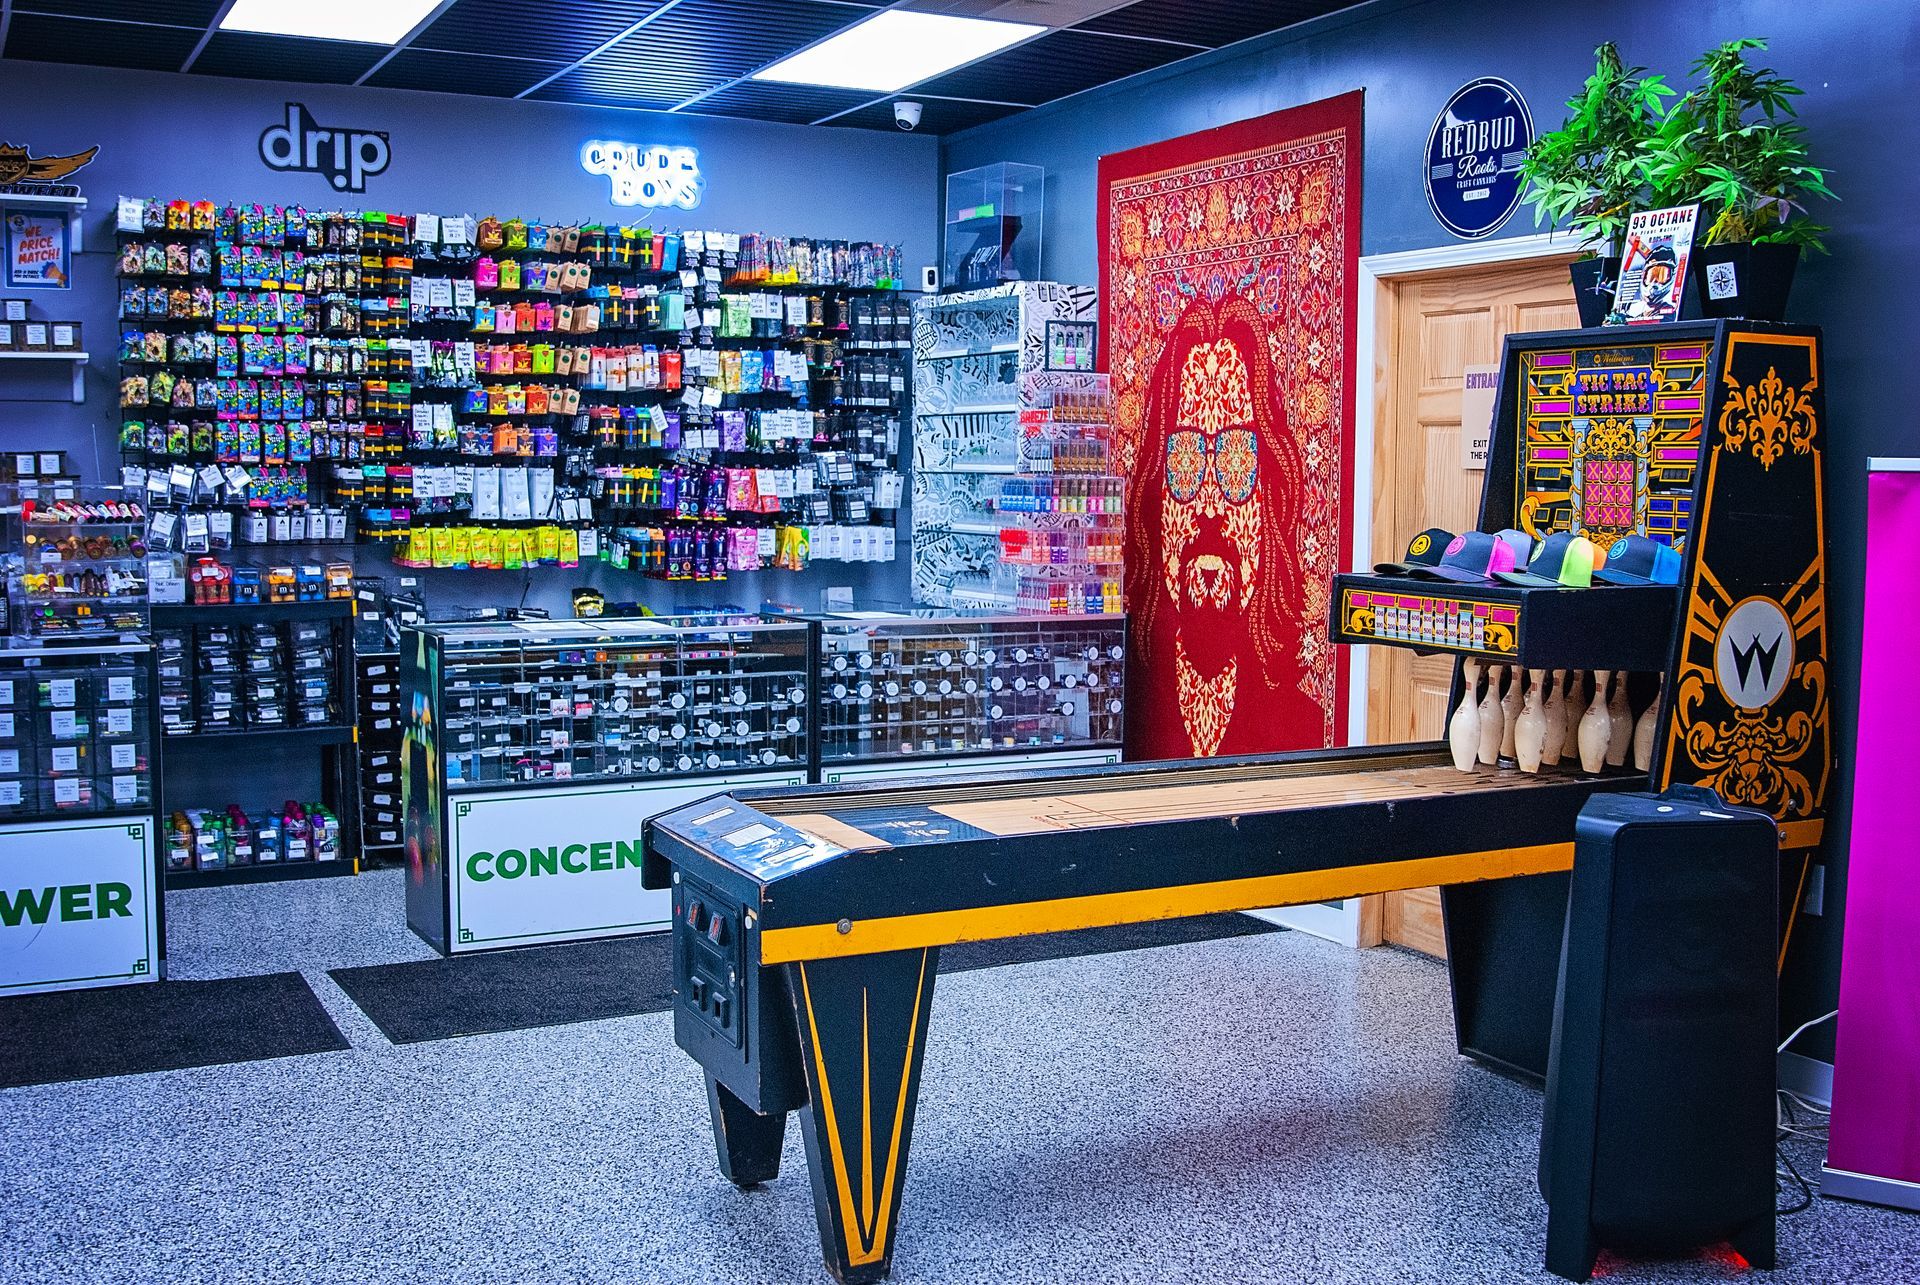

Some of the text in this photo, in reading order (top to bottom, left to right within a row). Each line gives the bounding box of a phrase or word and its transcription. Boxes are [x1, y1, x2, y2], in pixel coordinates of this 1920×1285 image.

[1441, 115, 1516, 159] REDBUD
[262, 105, 388, 189] drip
[582, 141, 699, 173] CRUDE
[1457, 155, 1496, 179] Roots
[1456, 175, 1497, 189] CRAFT CANNABIS
[612, 173, 697, 210] BOYS
[1632, 209, 1694, 229] 93 OCTANE
[25, 226, 42, 238] WE
[20, 238, 53, 252] PRICE
[18, 248, 60, 264] MATCH!
[1537, 357, 1542, 366] 1
[1661, 350, 1667, 360] 2
[1579, 372, 1647, 392] TIC TAC
[1534, 403, 1541, 412] 3
[1576, 393, 1649, 414] STRIKE
[1659, 400, 1666, 409] 4
[1470, 451, 1482, 459] THE
[1533, 450, 1539, 459] 5
[1657, 449, 1664, 459] 6
[1729, 632, 1783, 692] W
[466, 840, 642, 882] CONCEN
[0, 882, 133, 926] WER
